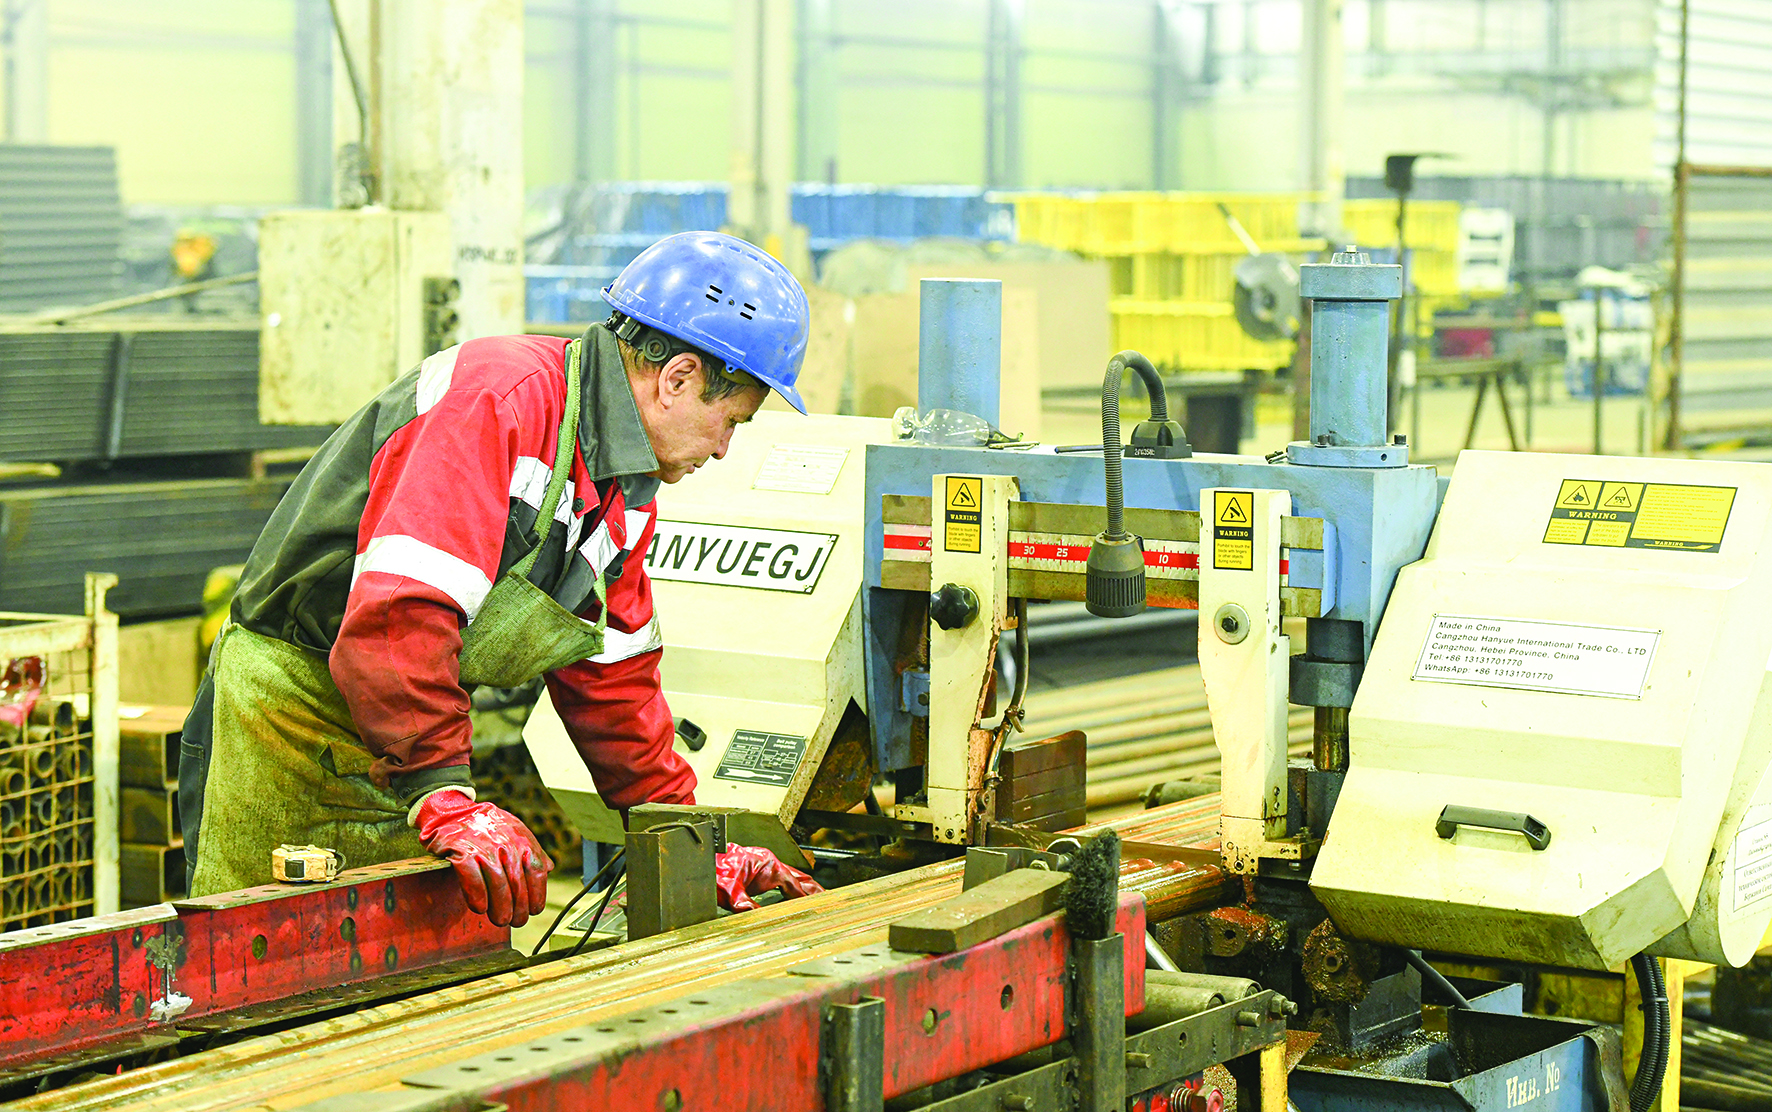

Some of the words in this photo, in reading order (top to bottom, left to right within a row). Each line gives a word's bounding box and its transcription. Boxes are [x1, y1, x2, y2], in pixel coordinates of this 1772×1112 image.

[1568, 510, 1618, 520] WARNING
[1024, 546, 1035, 555] 30
[1056, 548, 1068, 557] 25
[1159, 554, 1169, 564] 10
[1439, 622, 1462, 630] Made
[1476, 624, 1501, 632] China
[1436, 632, 1478, 642] Cangzhou
[1481, 635, 1514, 644] Hanyue
[1517, 638, 1574, 649] International
[1578, 642, 1602, 651] Trade
[1480, 646, 1506, 654] Hebei
[1554, 652, 1579, 660] China
[1464, 656, 1522, 666] 13131701770
[1425, 664, 1471, 674] WhatsApp:
[1495, 669, 1553, 680] 13131701770
[1545, 1062, 1560, 1094] №
